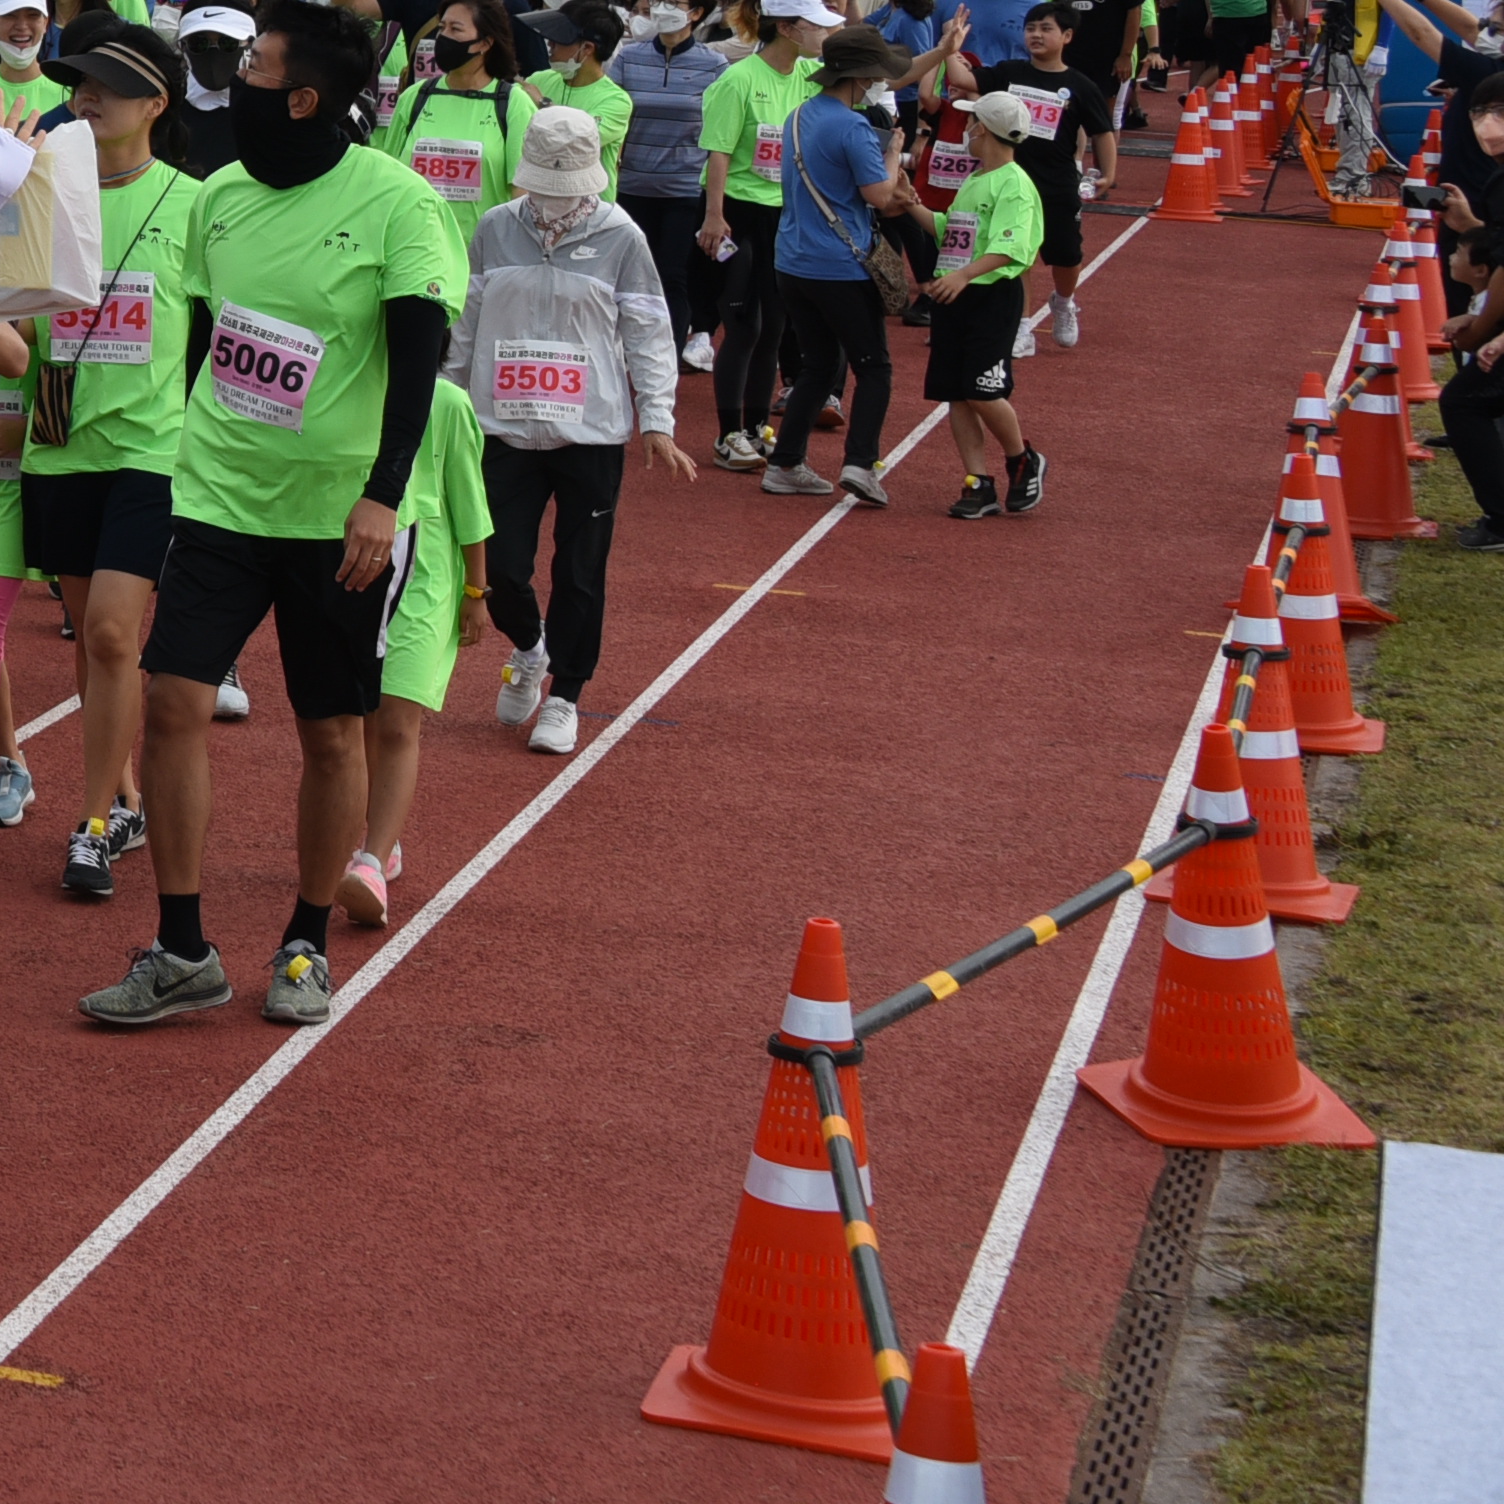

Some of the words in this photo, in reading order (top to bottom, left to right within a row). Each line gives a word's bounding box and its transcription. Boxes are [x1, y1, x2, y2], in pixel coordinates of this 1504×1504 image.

[413, 157, 477, 180] 5857
[932, 155, 980, 173] 5267
[111, 343, 142, 352] TOWER
[238, 321, 320, 357] 제주국제관광마라톤축제
[214, 334, 308, 393] 5006
[518, 350, 585, 363] 제주국제관광마라톤축제
[497, 365, 581, 394] 5503
[230, 387, 259, 407] DREAM
[261, 399, 293, 417] TOWER
[519, 402, 546, 410] DREAM
[549, 404, 577, 413] TOWER
